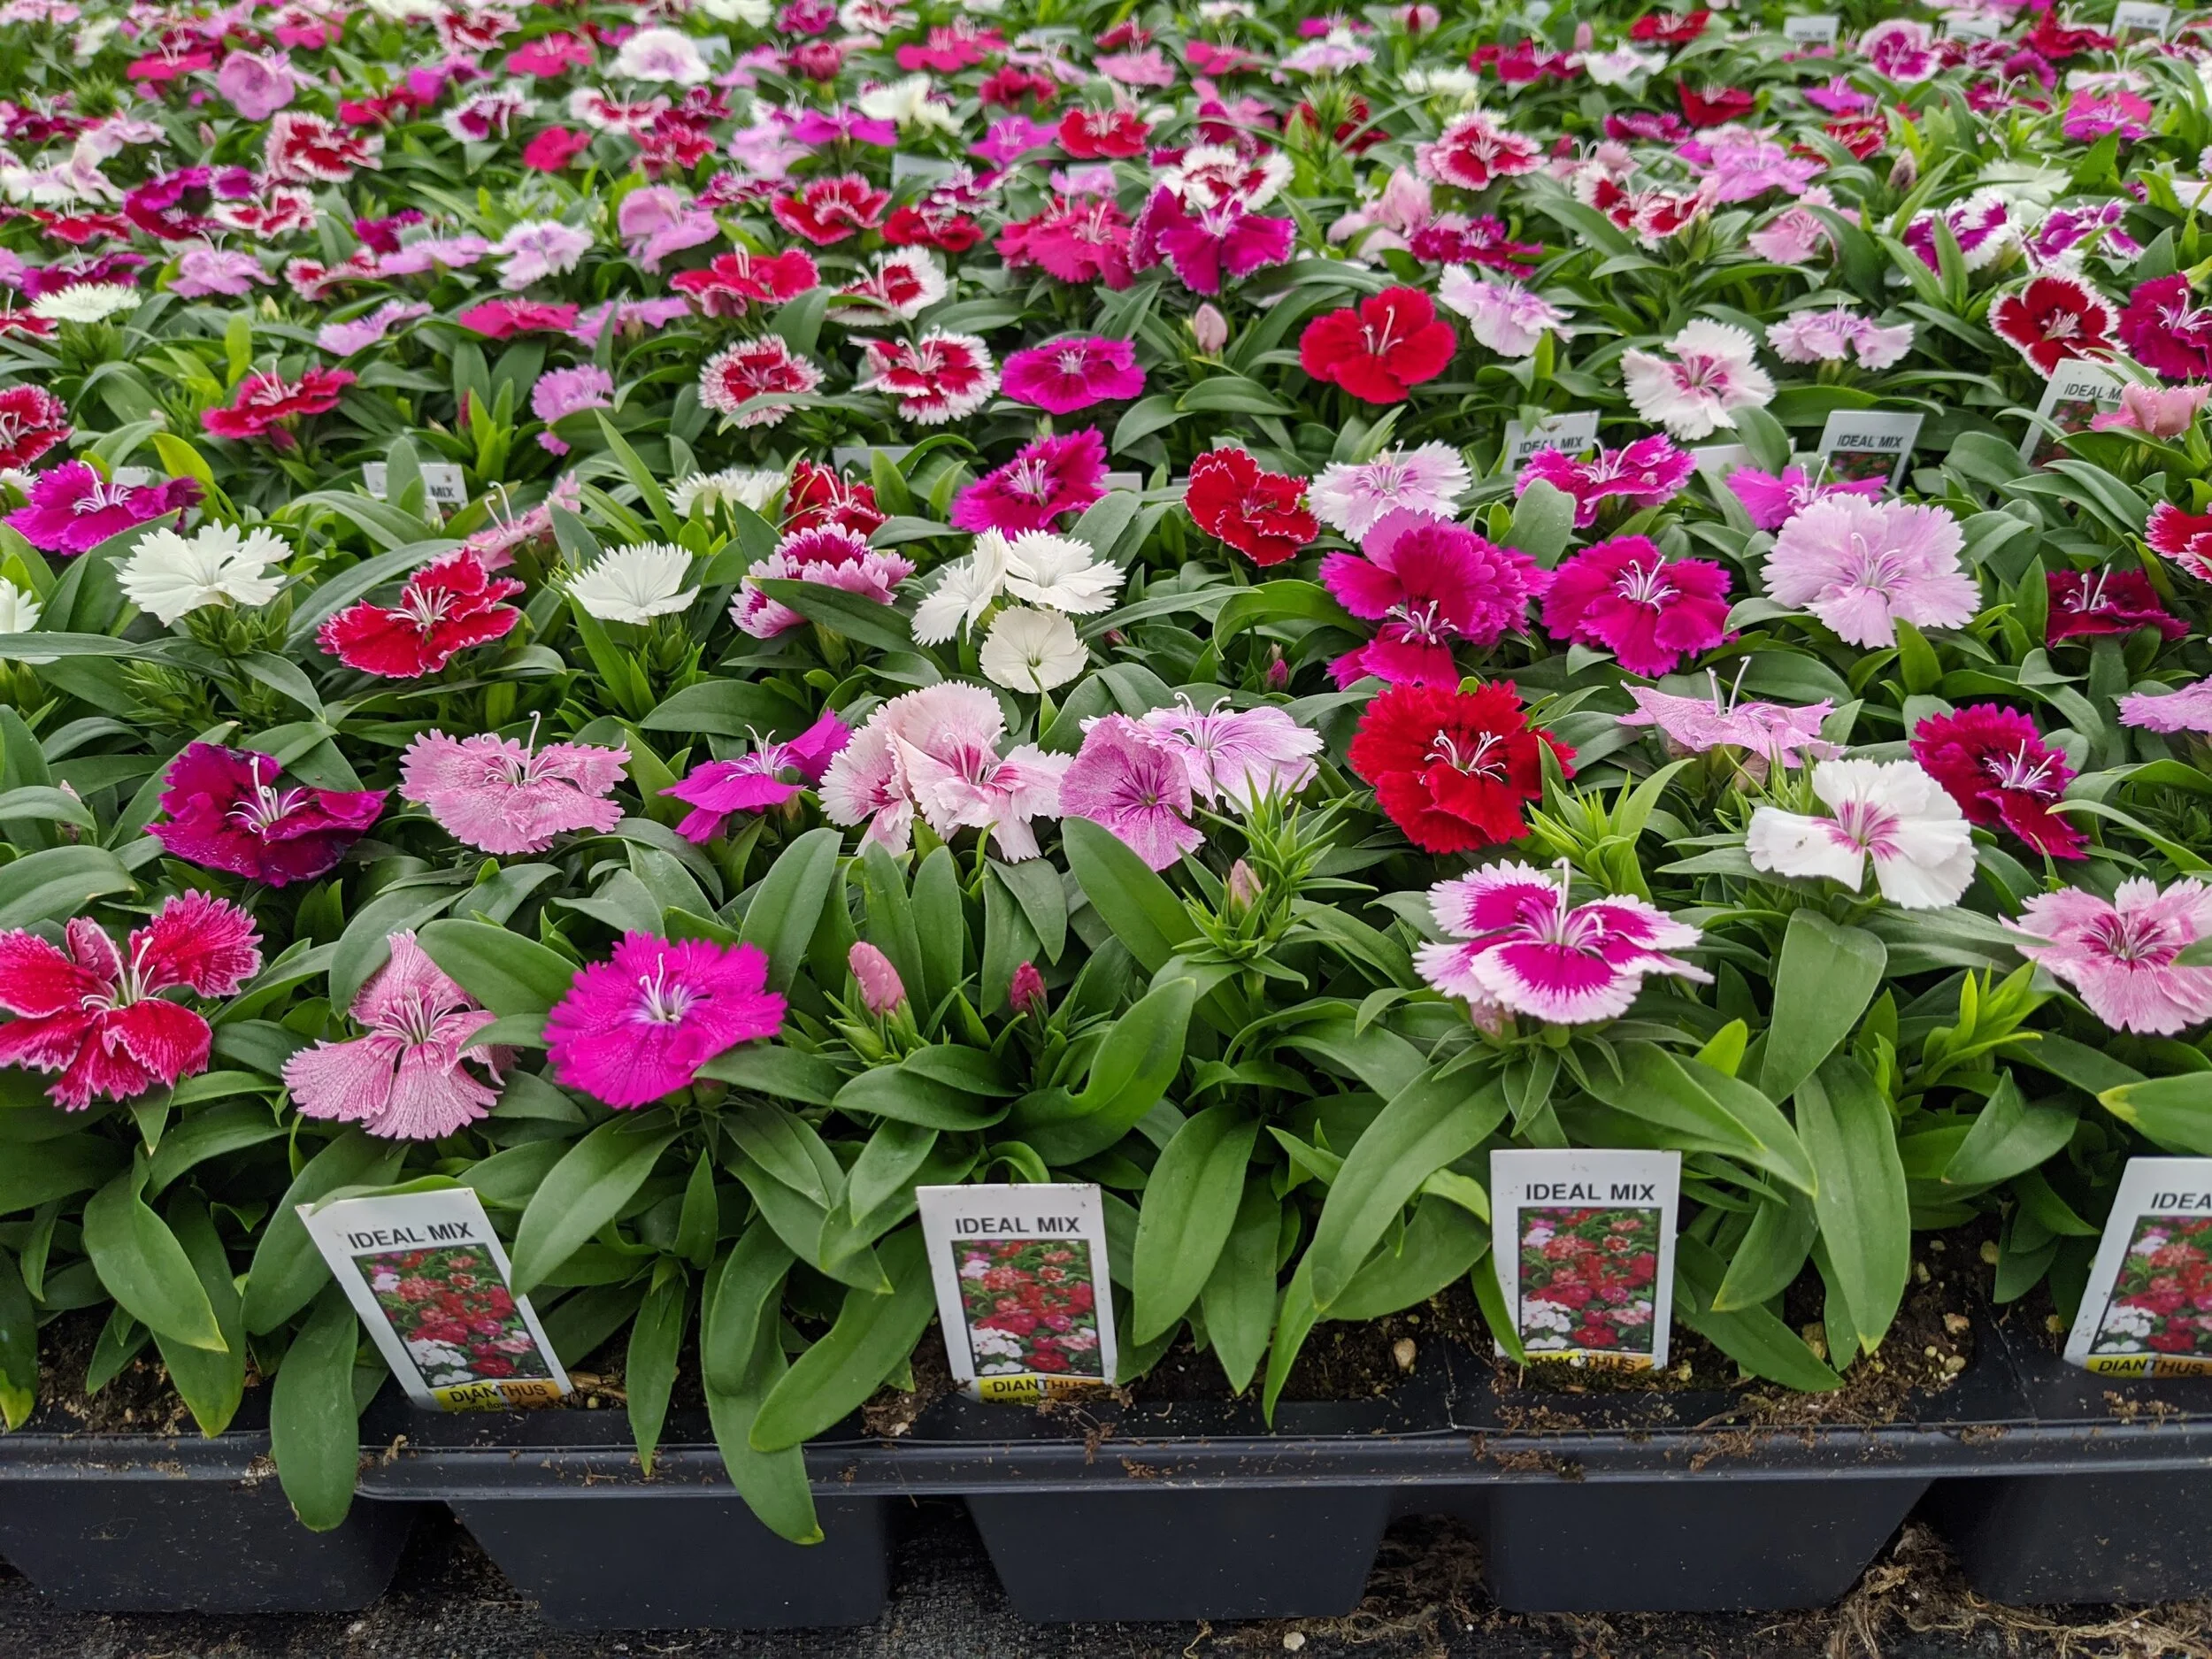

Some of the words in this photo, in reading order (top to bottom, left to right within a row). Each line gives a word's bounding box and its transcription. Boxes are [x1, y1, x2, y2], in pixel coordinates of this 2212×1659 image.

[2063, 382, 2104, 398] IDEAL
[1560, 436, 1585, 449] MIX
[1837, 434, 1875, 448] IDEAL
[1878, 435, 1904, 449] MIX
[430, 485, 456, 498] MIX
[1525, 1182, 1601, 1201] IDEAL
[1610, 1183, 1655, 1201] MIX
[2150, 1192, 2212, 1210] IDEA
[956, 1217, 1030, 1234] IDEAL
[1037, 1217, 1081, 1233] MIX
[347, 1226, 426, 1249] IDEAL
[427, 1221, 475, 1240] MIX
[2098, 1358, 2205, 1375] DIANTHUS
[449, 1384, 548, 1403] DIANTHUS
[992, 1379, 1090, 1393] DIANTHU
